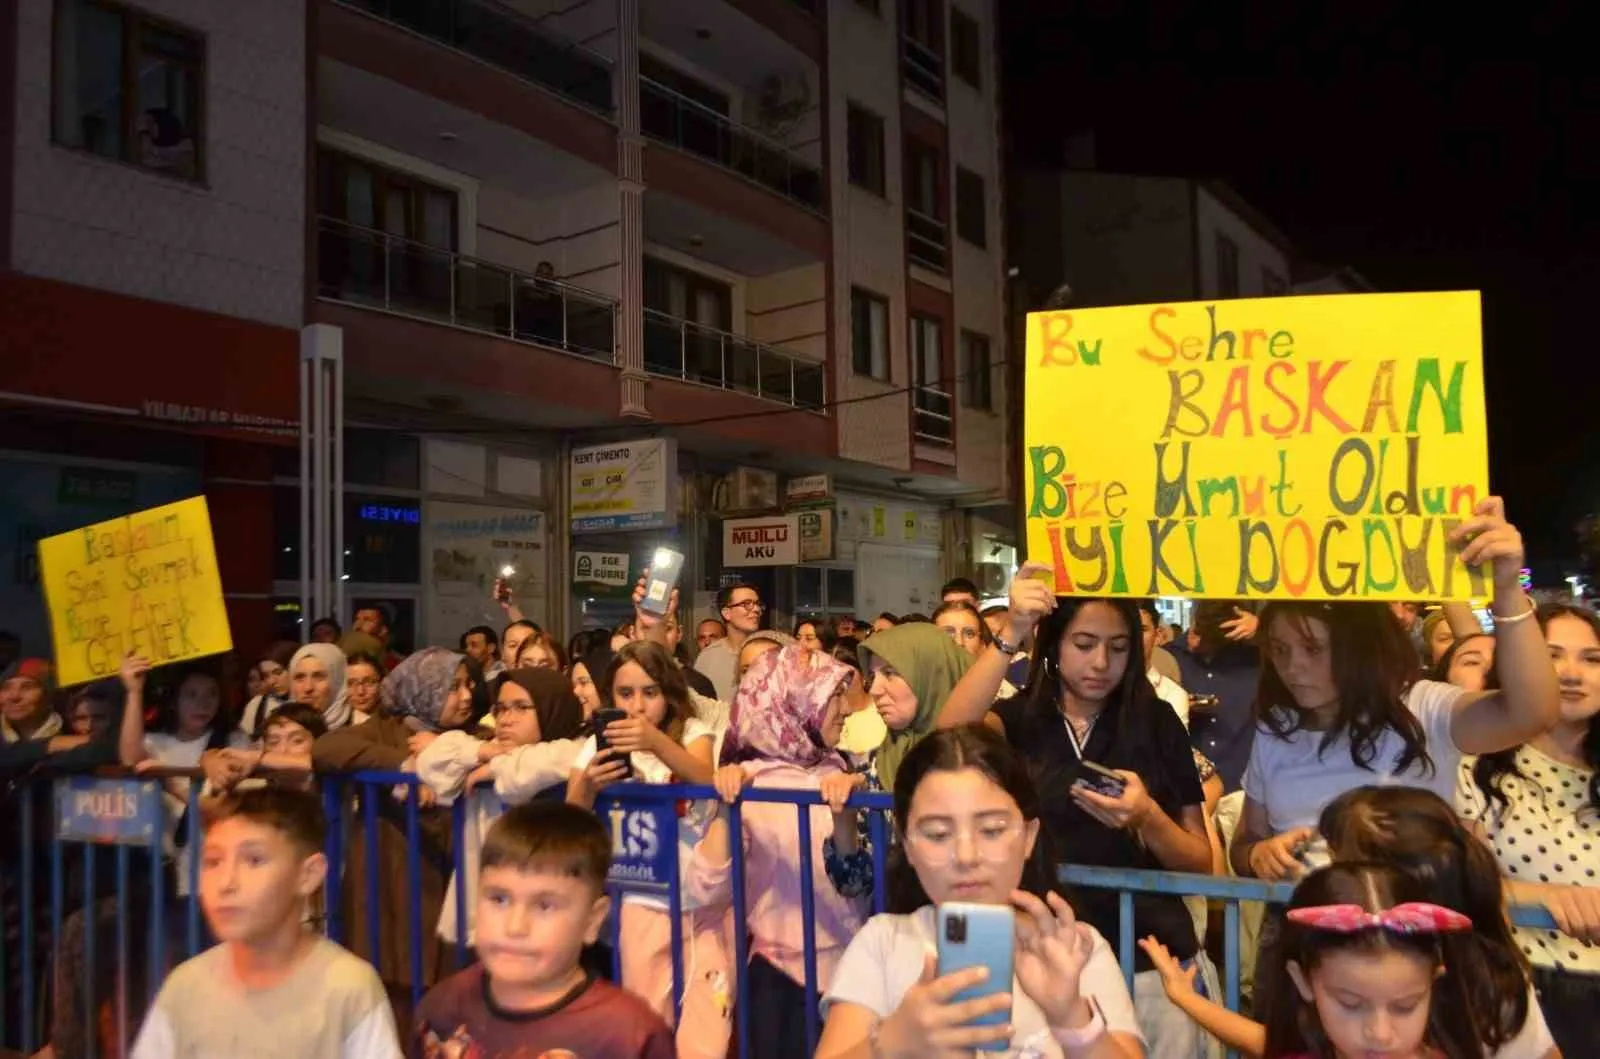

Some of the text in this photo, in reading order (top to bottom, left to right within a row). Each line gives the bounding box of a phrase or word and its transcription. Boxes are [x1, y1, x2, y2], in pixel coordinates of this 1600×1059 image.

[1039, 305, 1294, 367] Bu Sehre
[1160, 357, 1469, 440] BAŞKAN
[1028, 436, 1475, 519] Bize Umut Oldun
[75, 787, 138, 819] POLİS
